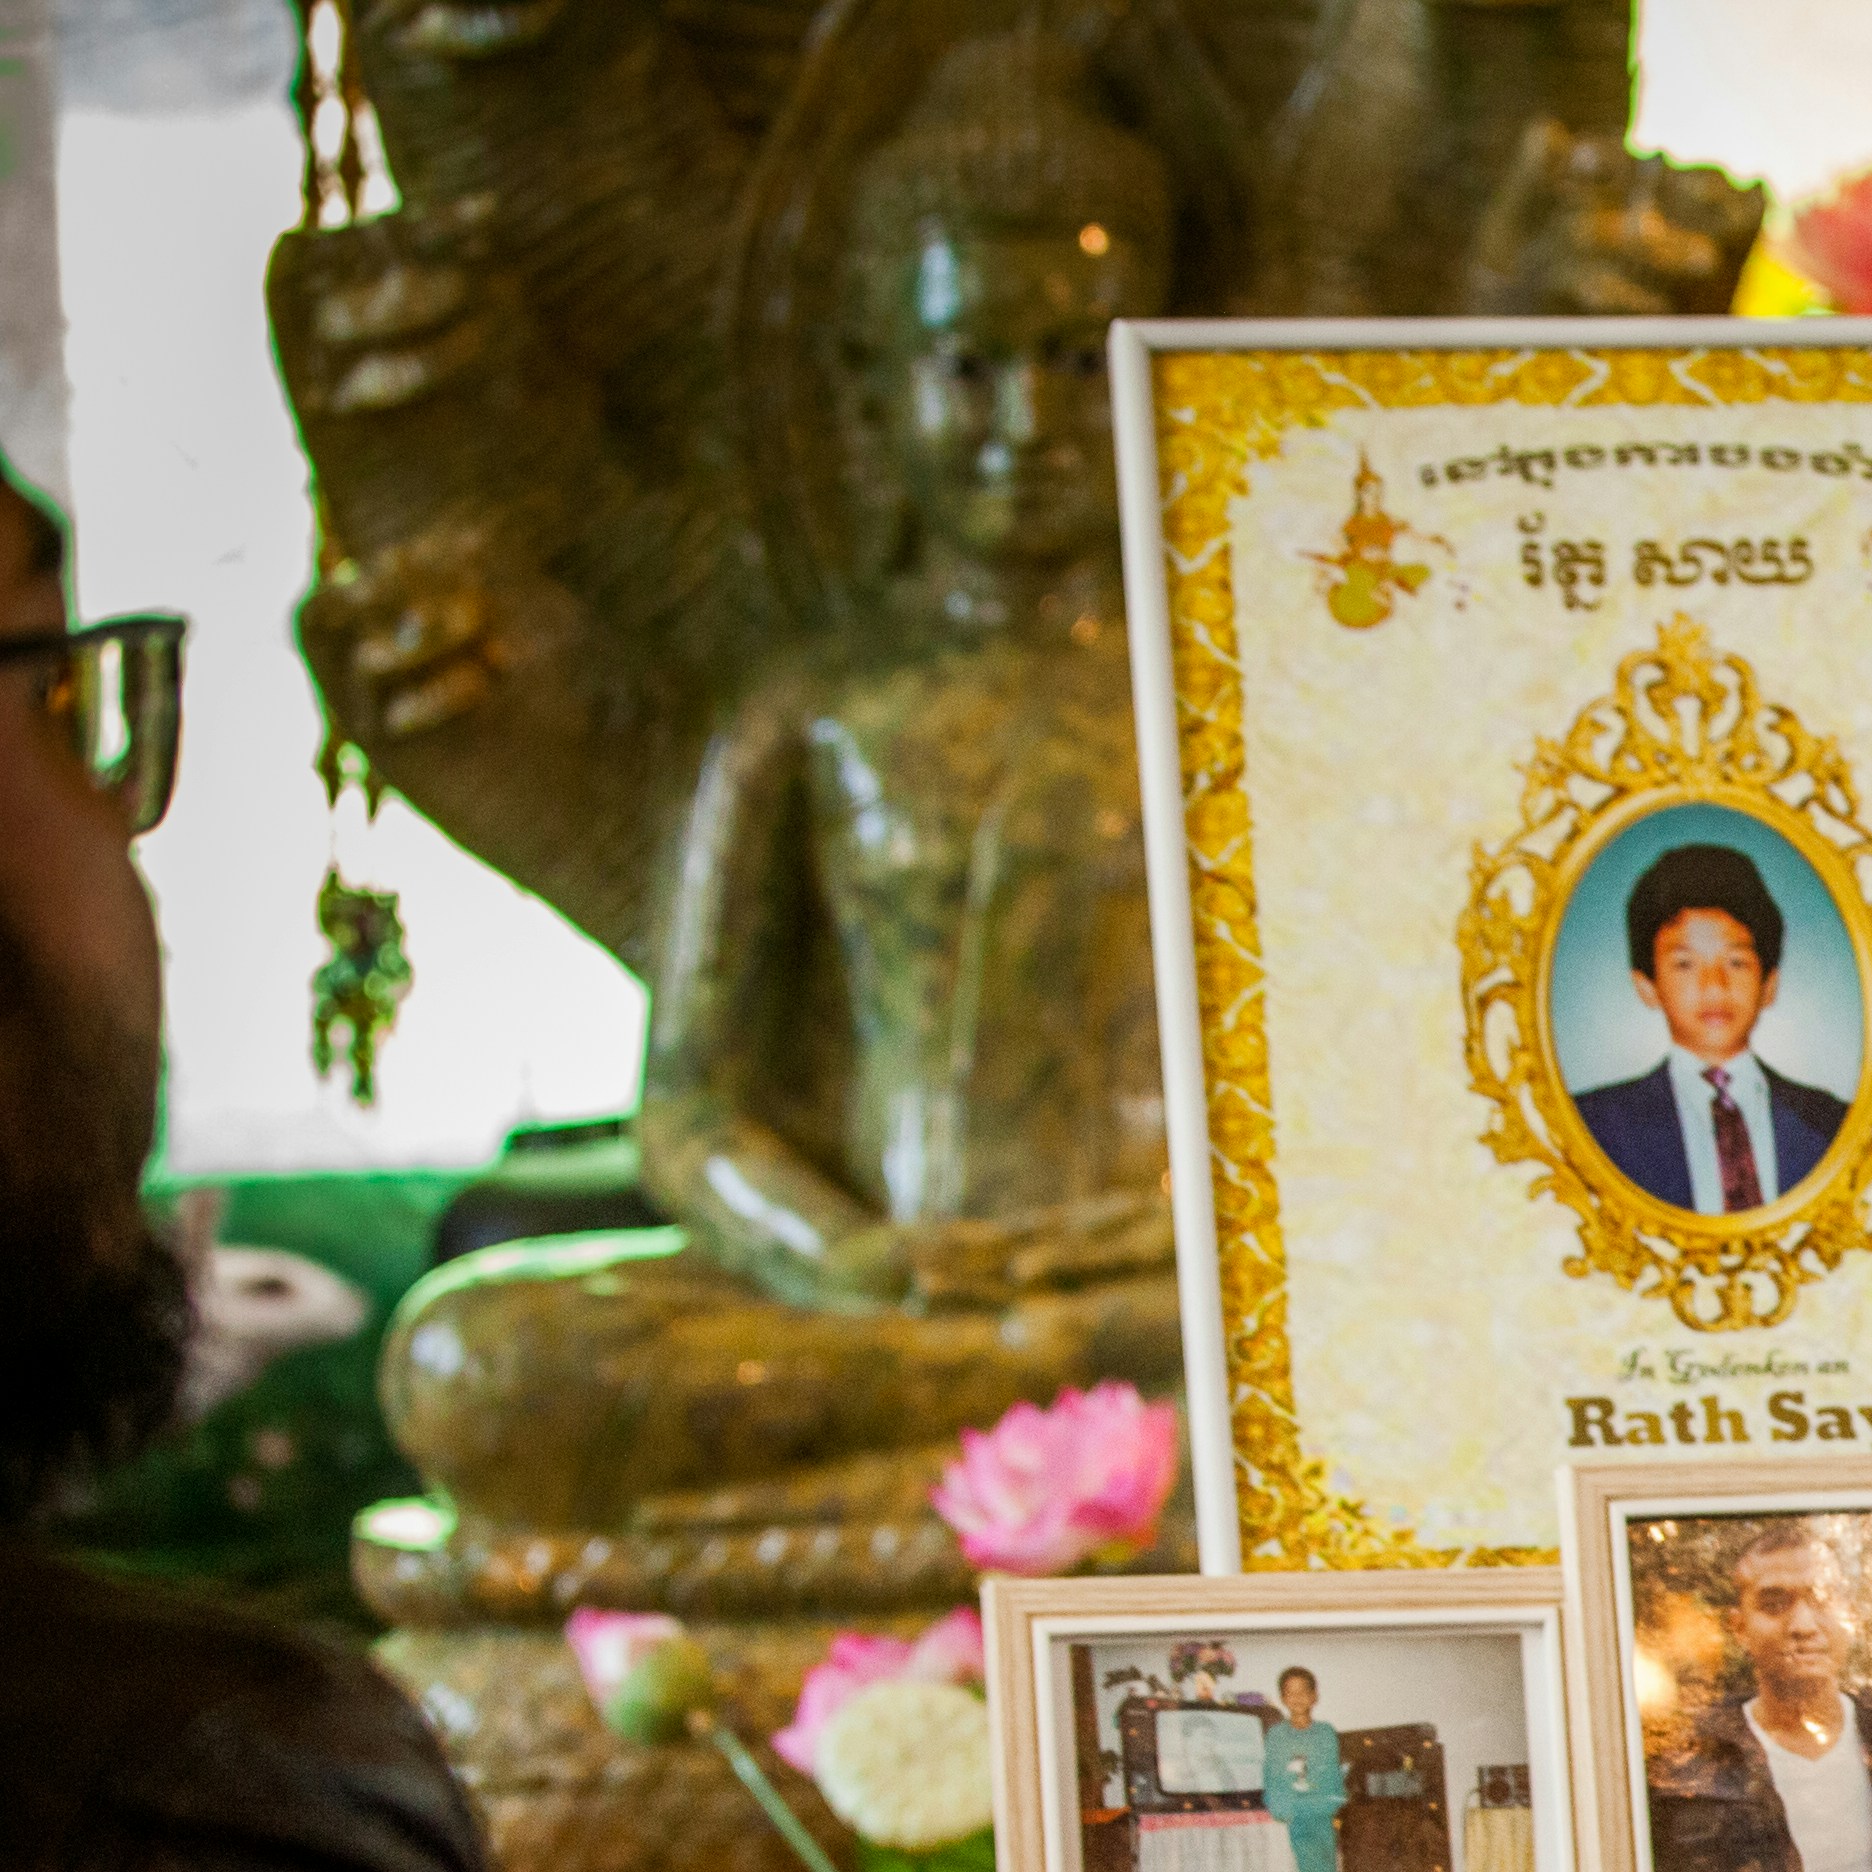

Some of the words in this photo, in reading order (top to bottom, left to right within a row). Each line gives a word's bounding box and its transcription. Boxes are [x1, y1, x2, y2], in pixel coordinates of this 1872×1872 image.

[1619, 1347, 1656, 1383] In
[1815, 1359, 1850, 1375] an
[1565, 1394, 1751, 1448] Rath
